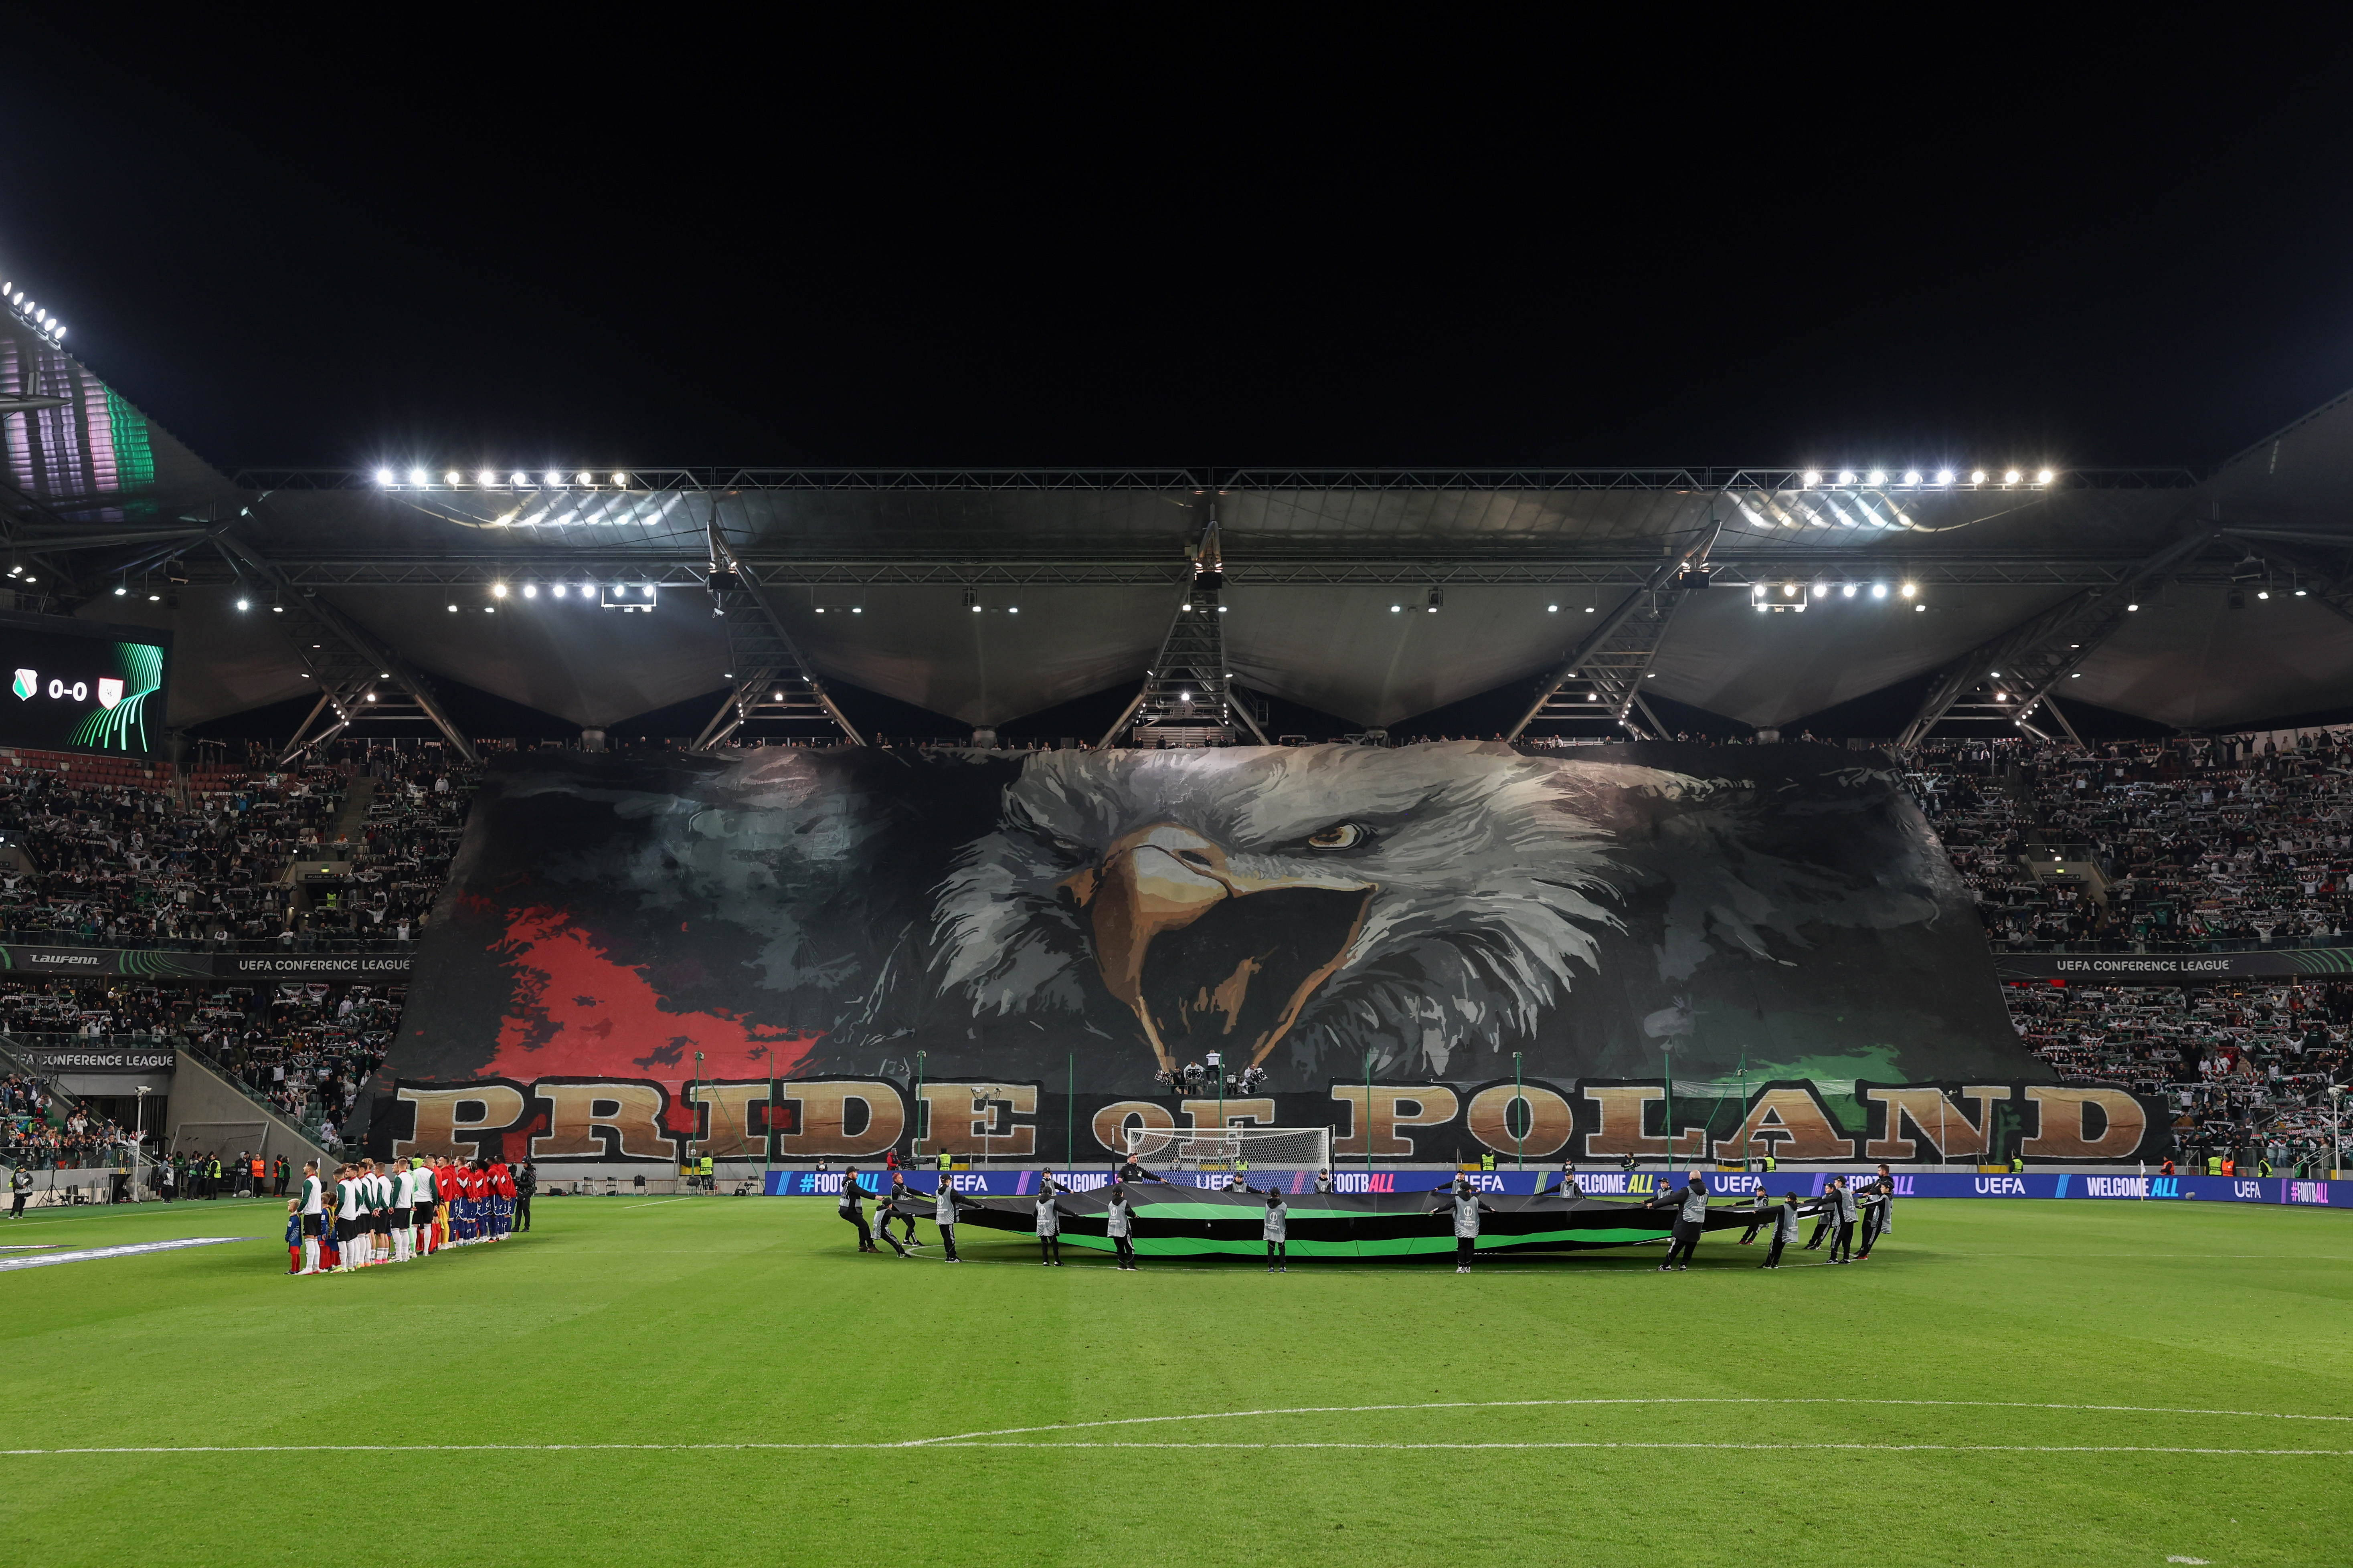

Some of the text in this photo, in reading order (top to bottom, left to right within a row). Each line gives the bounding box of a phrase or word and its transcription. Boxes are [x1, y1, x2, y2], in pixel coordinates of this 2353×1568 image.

[49, 679, 87, 702] 0-0
[239, 960, 410, 971] UEFA CONFERENCE LEAGUE
[2057, 960, 2230, 972] UEFA CONFERENCE LEAGUE
[126, 1055, 173, 1067] LEAGUE
[392, 1081, 2147, 1161] PRIDE OF POLAND
[799, 1173, 879, 1193] #FOOTALL
[1197, 1175, 1234, 1190] UEF
[1627, 1174, 1654, 1193] ALL
[1714, 1176, 1763, 1193] UEFA
[1975, 1177, 2026, 1194] UEFA
[2086, 1177, 2179, 1197] WELCOME ALL
[2234, 1180, 2261, 1199] UEFA
[2291, 1182, 2329, 1204] #FOOTBALL
